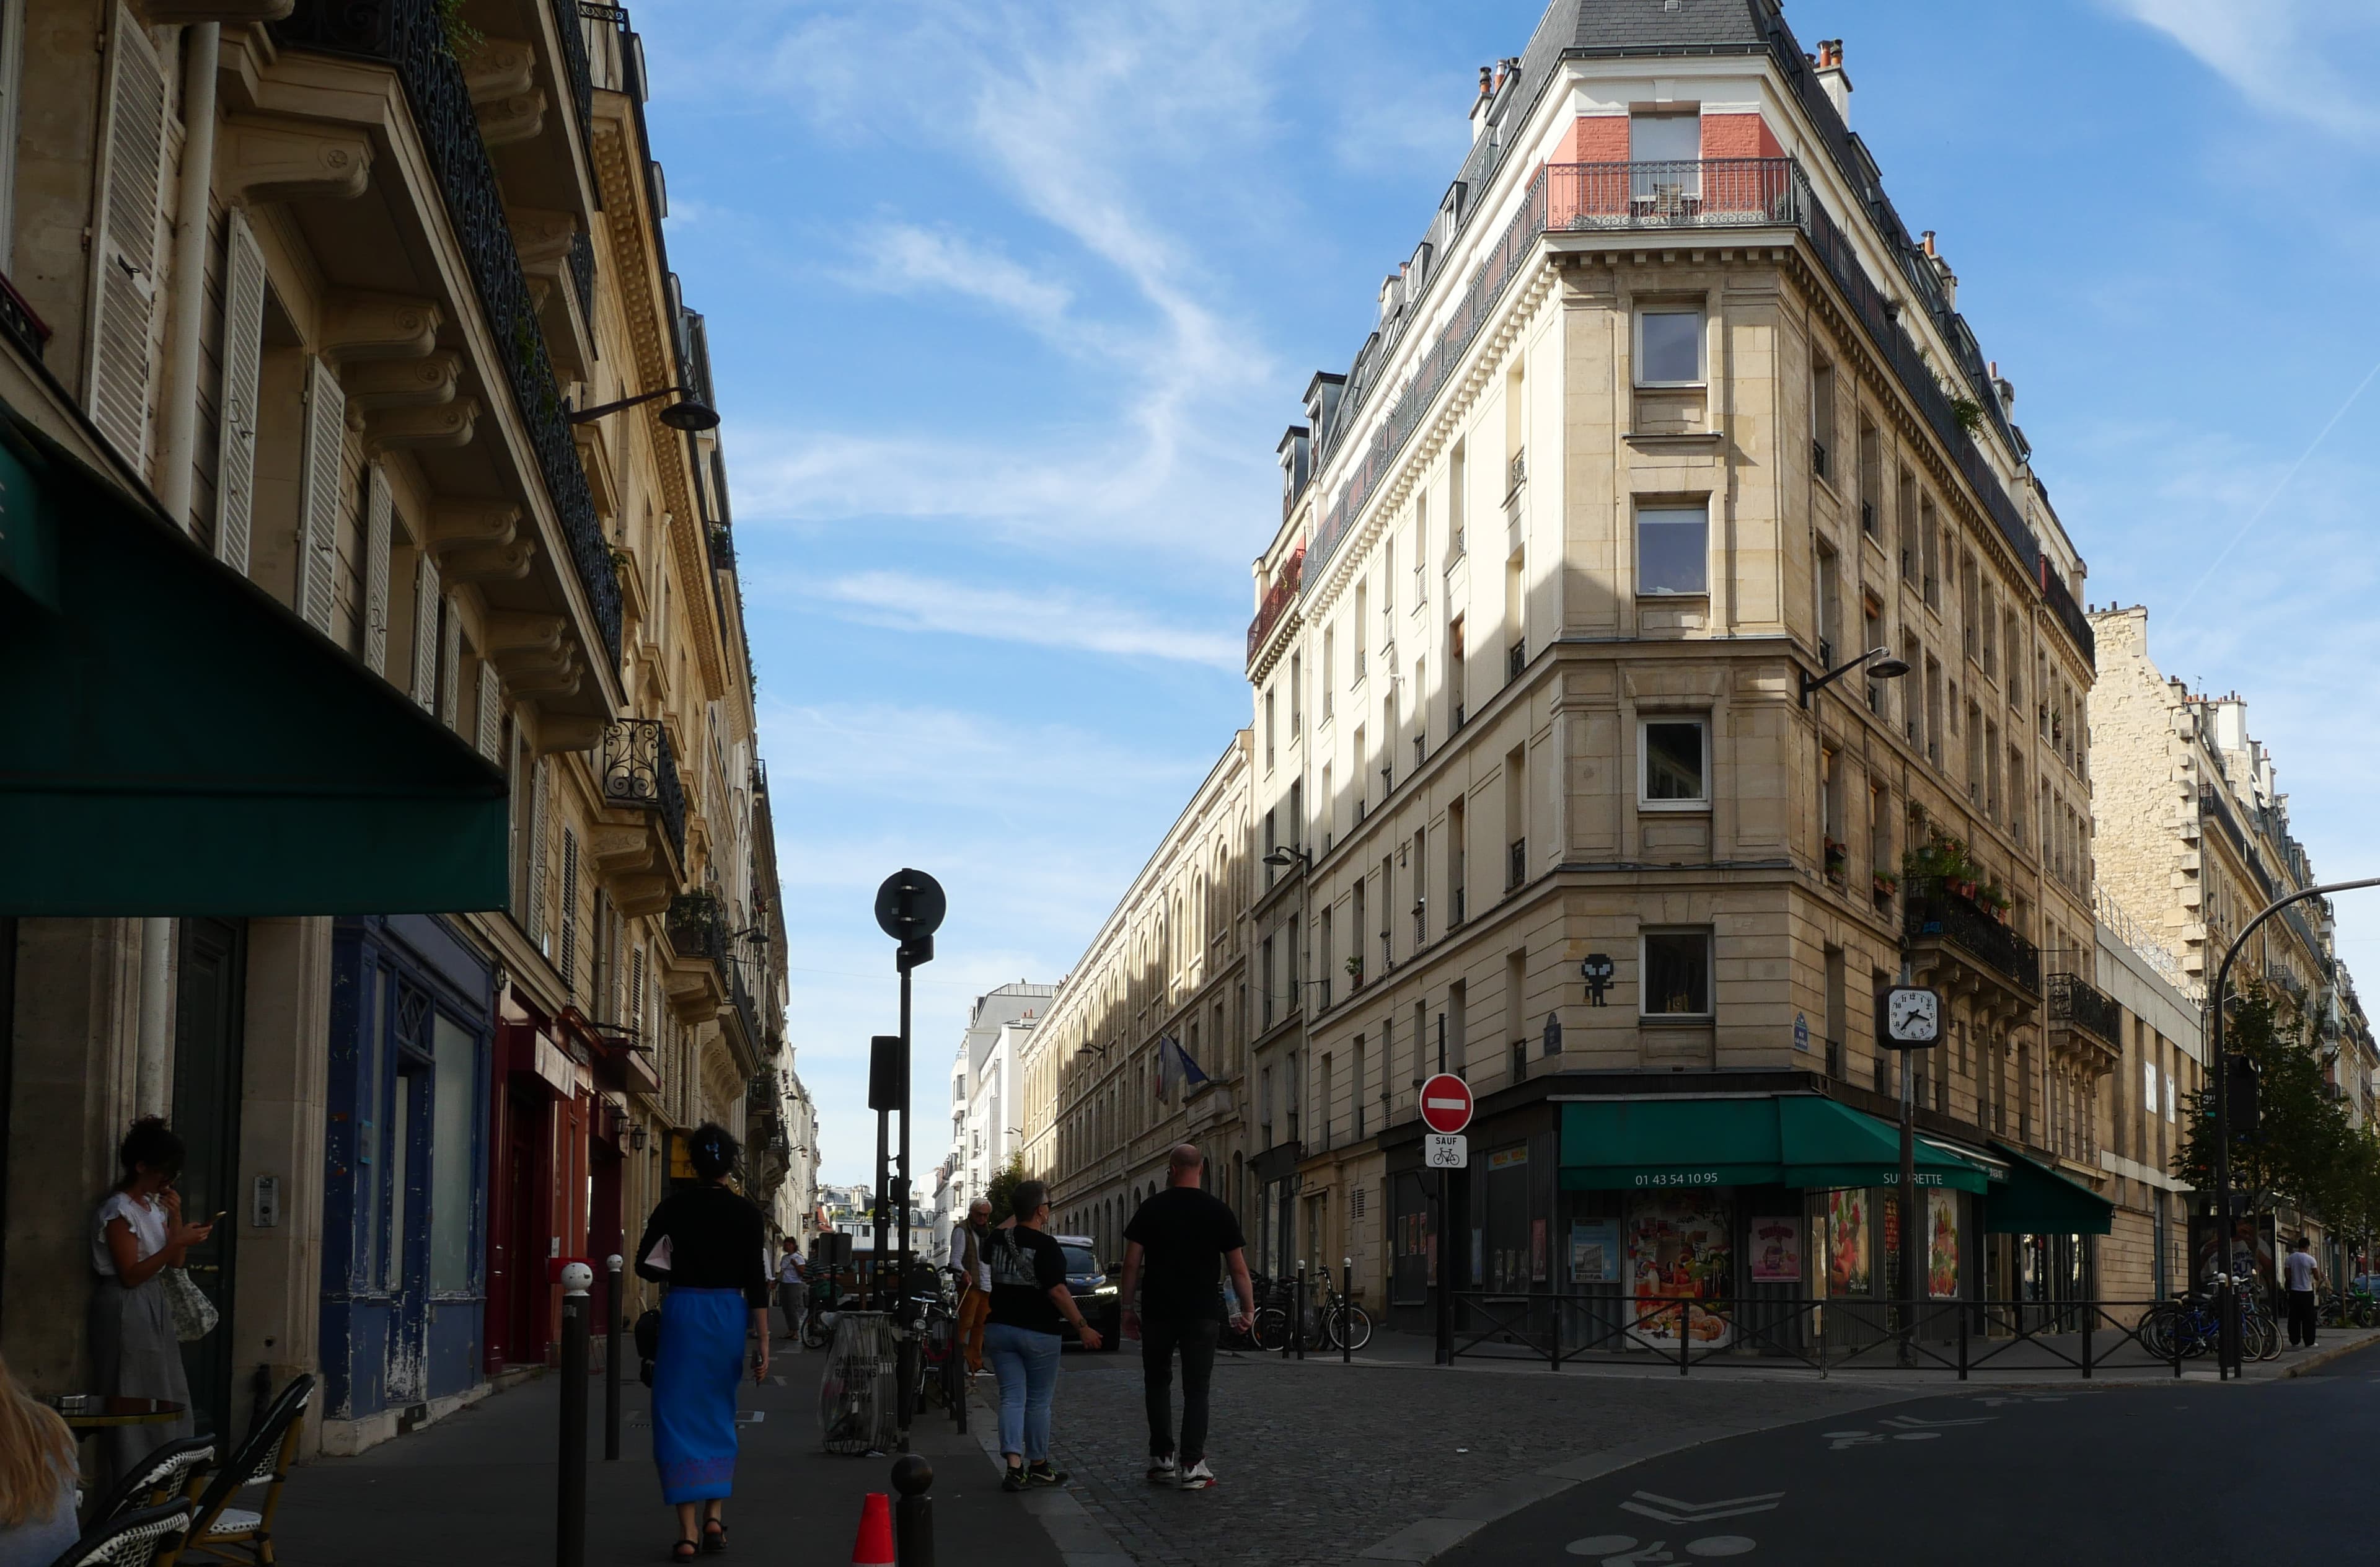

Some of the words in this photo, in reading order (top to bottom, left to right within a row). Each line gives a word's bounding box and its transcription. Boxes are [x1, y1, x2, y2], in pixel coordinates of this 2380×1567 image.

[1435, 1137, 1457, 1145] SAUF
[1636, 1175, 1649, 1185] 01
[1652, 1175, 1667, 1185] 43
[1670, 1174, 1685, 1185] 54
[1688, 1173, 1701, 1184] 10
[1704, 1172, 1718, 1183] 95
[1884, 1173, 1944, 1185] SURETTE
